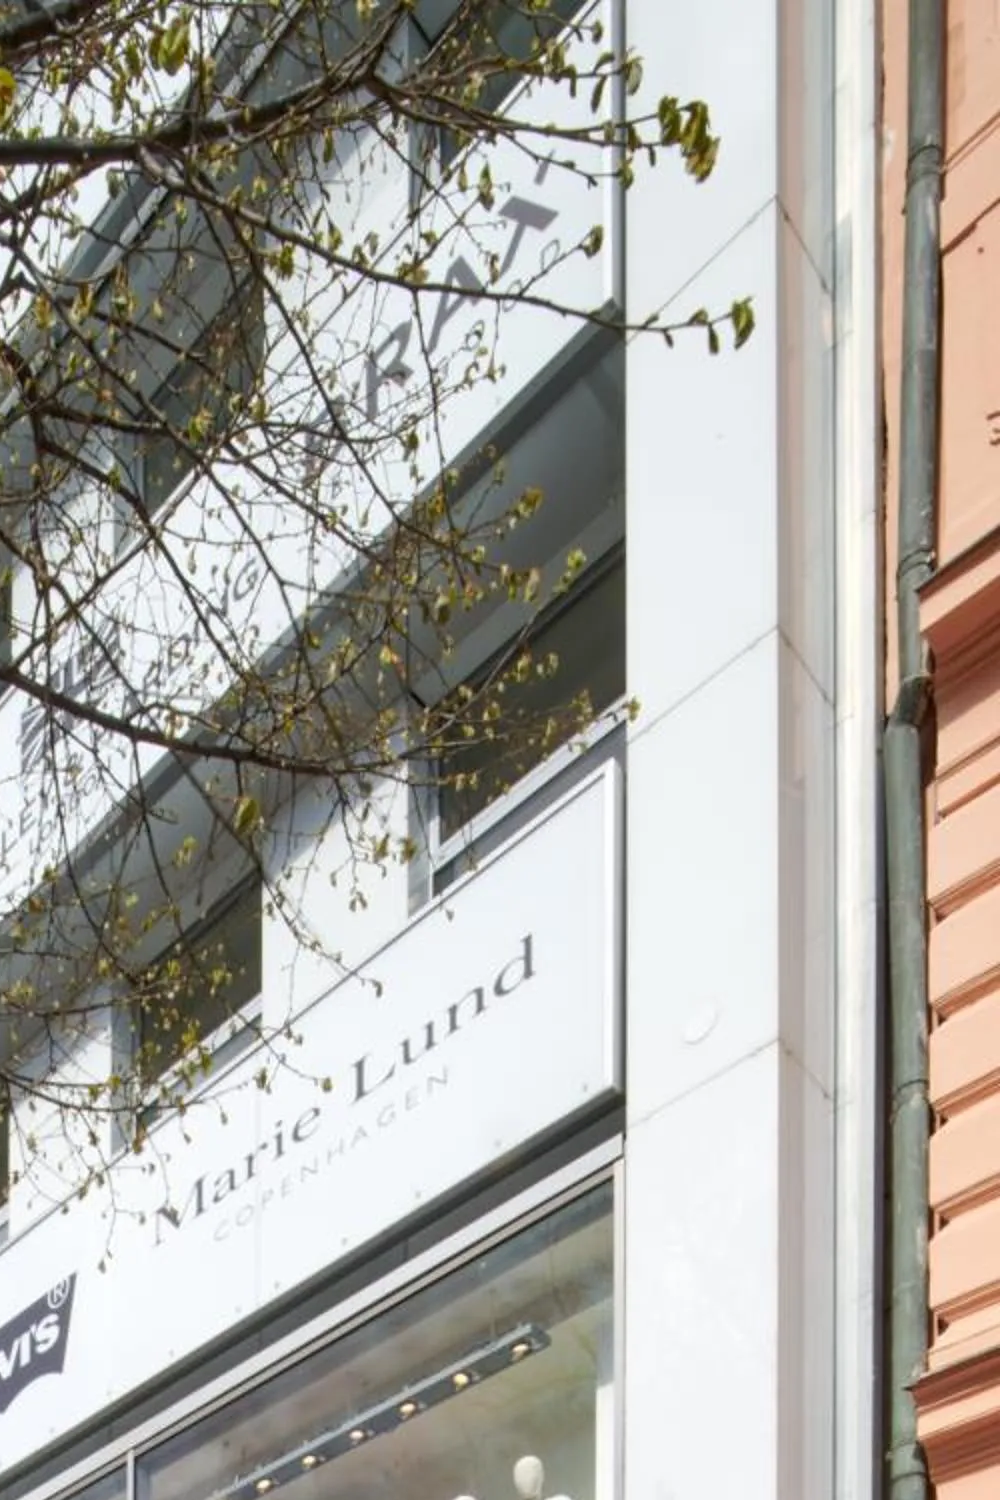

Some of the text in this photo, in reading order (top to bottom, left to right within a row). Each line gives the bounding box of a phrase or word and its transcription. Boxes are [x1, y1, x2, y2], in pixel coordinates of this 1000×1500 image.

[154, 932, 536, 1245] Marie Lund
[213, 1066, 450, 1243] COPENHAGEN
